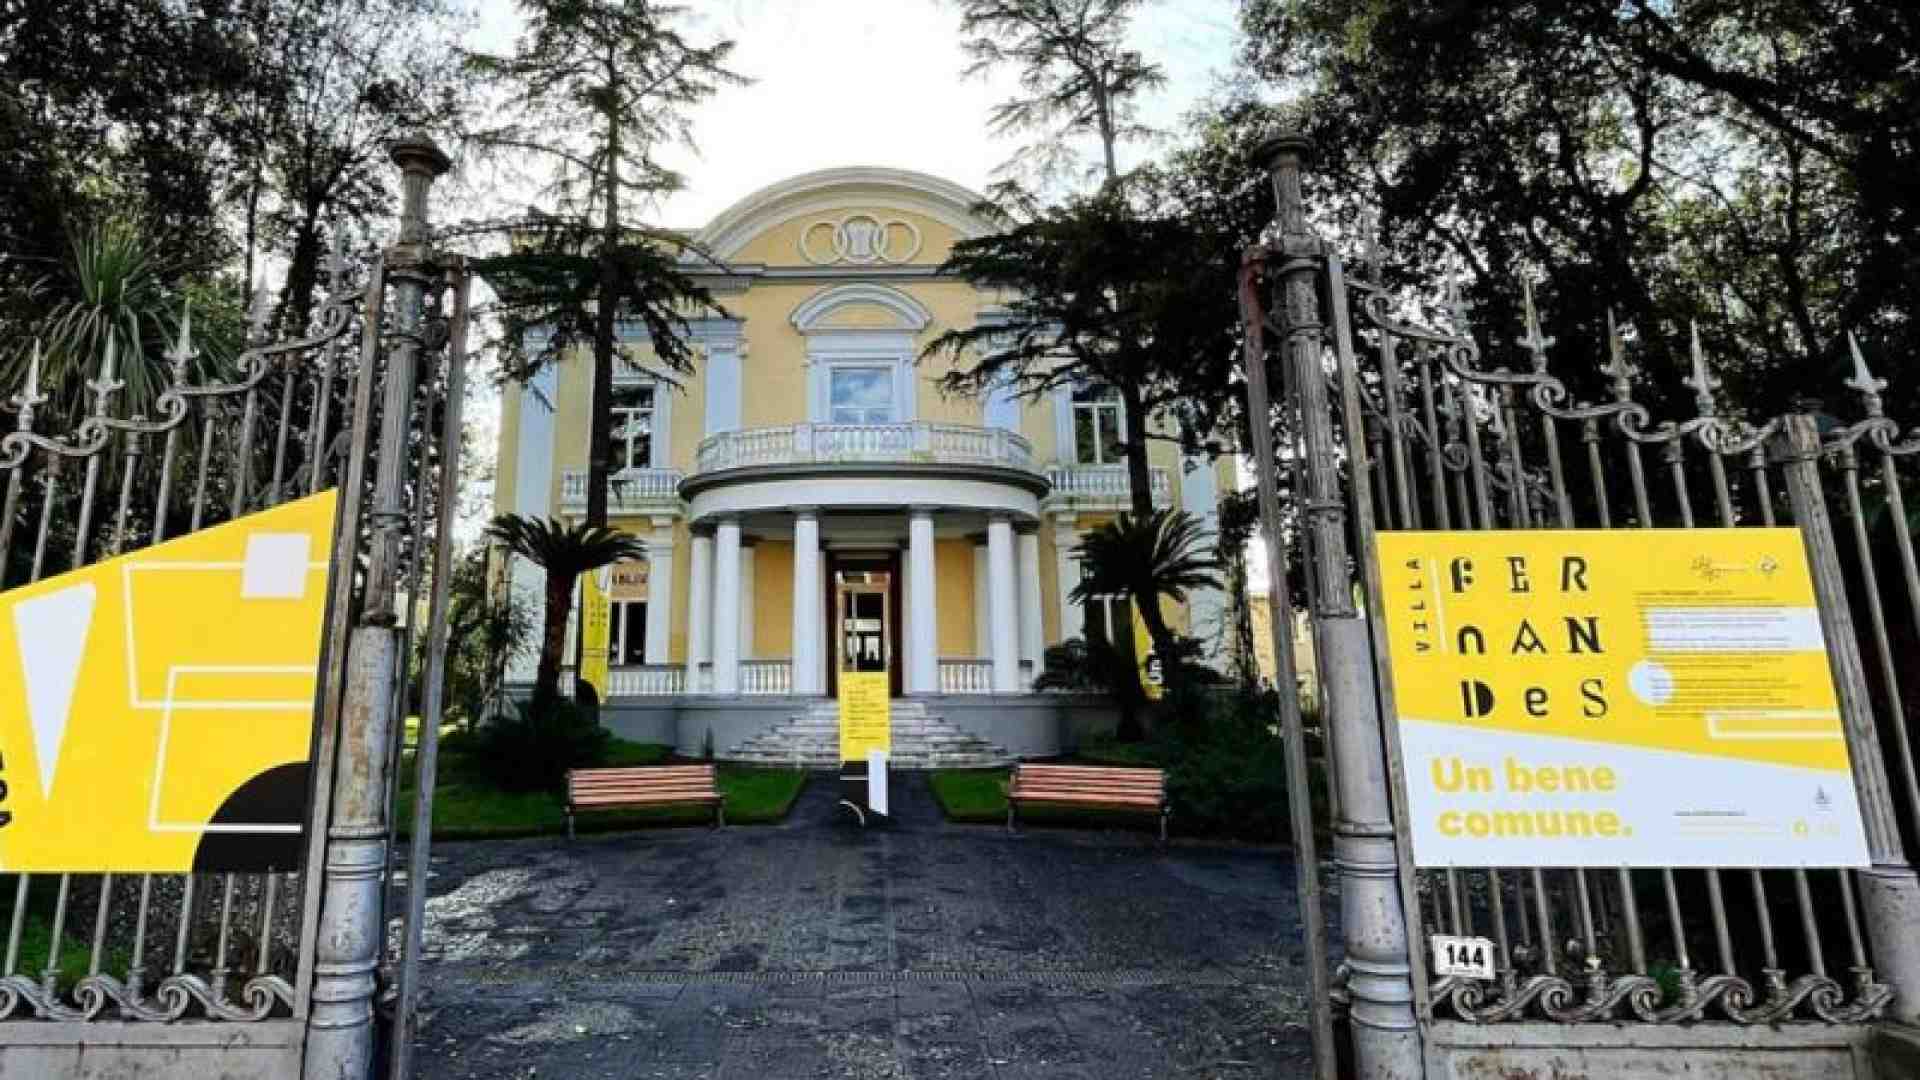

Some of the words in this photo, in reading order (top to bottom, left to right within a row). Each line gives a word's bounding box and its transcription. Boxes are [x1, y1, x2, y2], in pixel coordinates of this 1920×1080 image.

[1405, 557, 1431, 652] VILLA
[1430, 756, 1493, 793] Un
[1504, 753, 1616, 793] bene
[1436, 810, 1634, 838] comune.
[1446, 944, 1486, 968] 144
